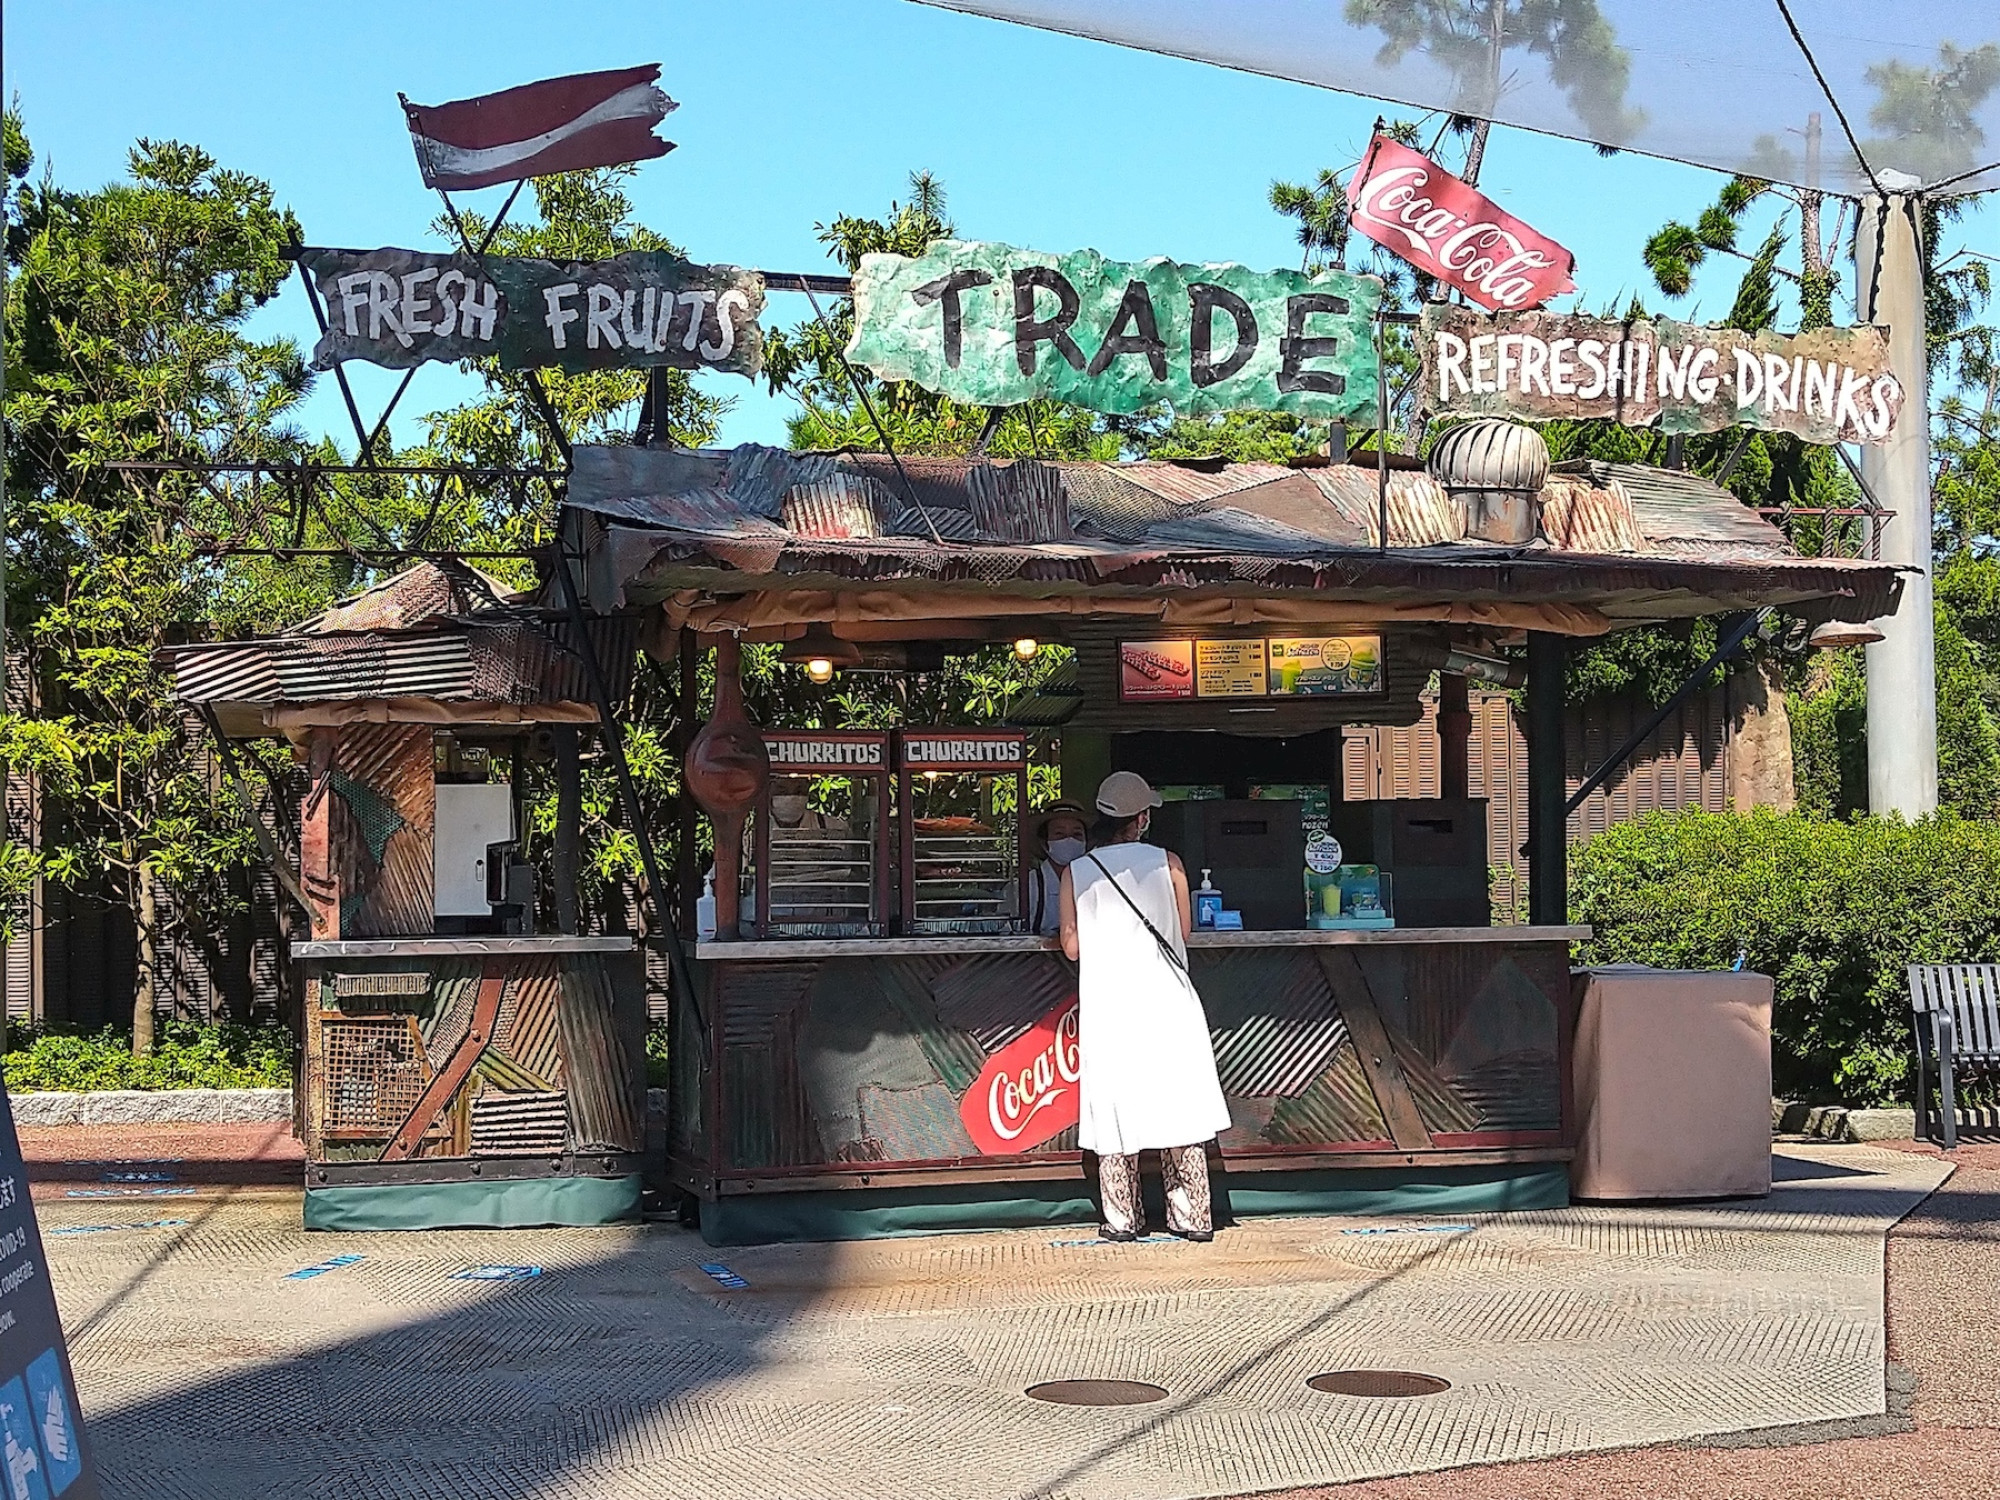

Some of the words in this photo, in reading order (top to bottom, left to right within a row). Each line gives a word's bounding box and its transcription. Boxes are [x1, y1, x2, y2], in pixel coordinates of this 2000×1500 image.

[1357, 166, 1556, 307] Coca-Cola
[337, 267, 499, 348] FRESH
[542, 282, 749, 361] FRUITS
[911, 266, 1351, 395] TRADE
[766, 741, 882, 764] CHURRITOS
[906, 739, 1021, 762] CHURRITOS
[988, 1003, 1080, 1140] Coca-C
